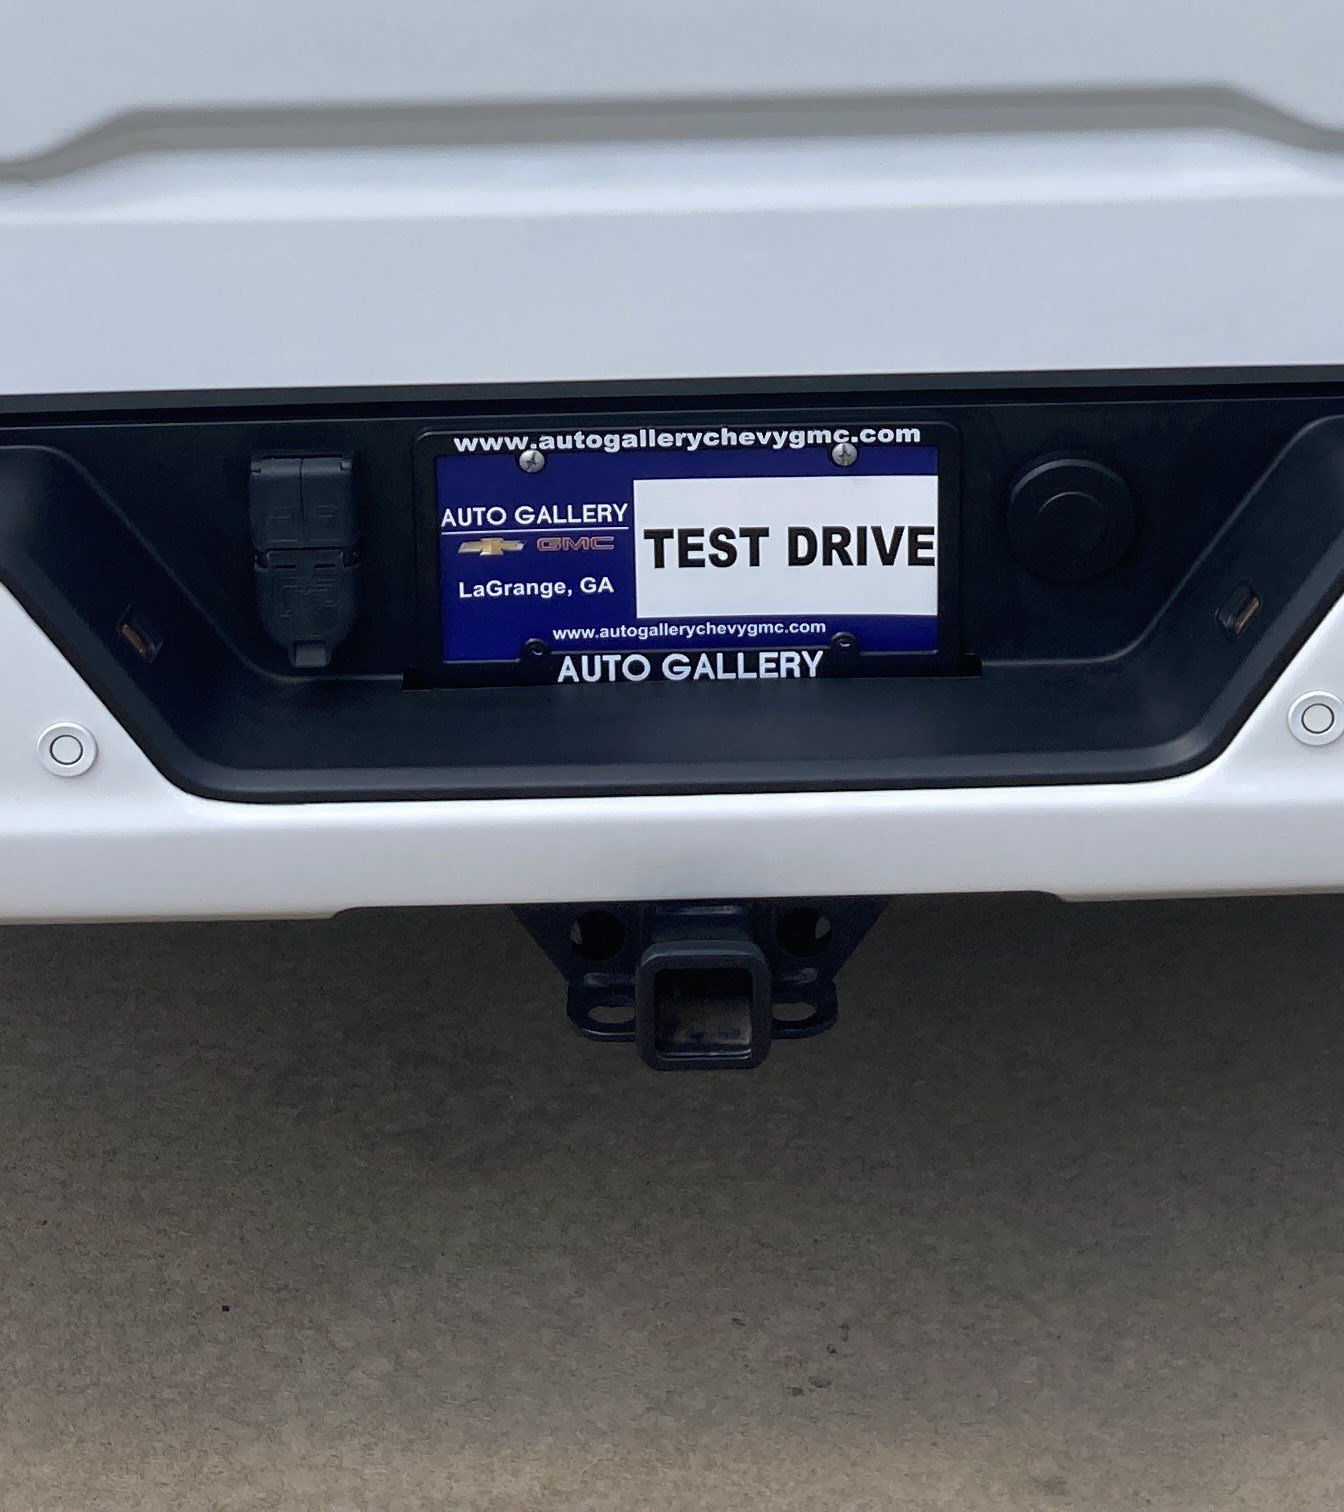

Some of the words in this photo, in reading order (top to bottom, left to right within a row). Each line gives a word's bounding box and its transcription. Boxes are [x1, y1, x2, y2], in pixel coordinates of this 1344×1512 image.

[453, 427, 921, 453] www.autogallerychevygmc.com
[441, 506, 507, 528] AUTO
[514, 502, 629, 526] GALLERY
[536, 536, 615, 552] GMC
[643, 526, 770, 570] TEST
[786, 525, 936, 568] DRIVE
[458, 579, 573, 599] LaGrange,
[579, 576, 615, 594] GA
[552, 620, 826, 640] www.autogallerychevygmc.com
[557, 654, 652, 684] AUTO
[661, 650, 824, 682] GALLERY
